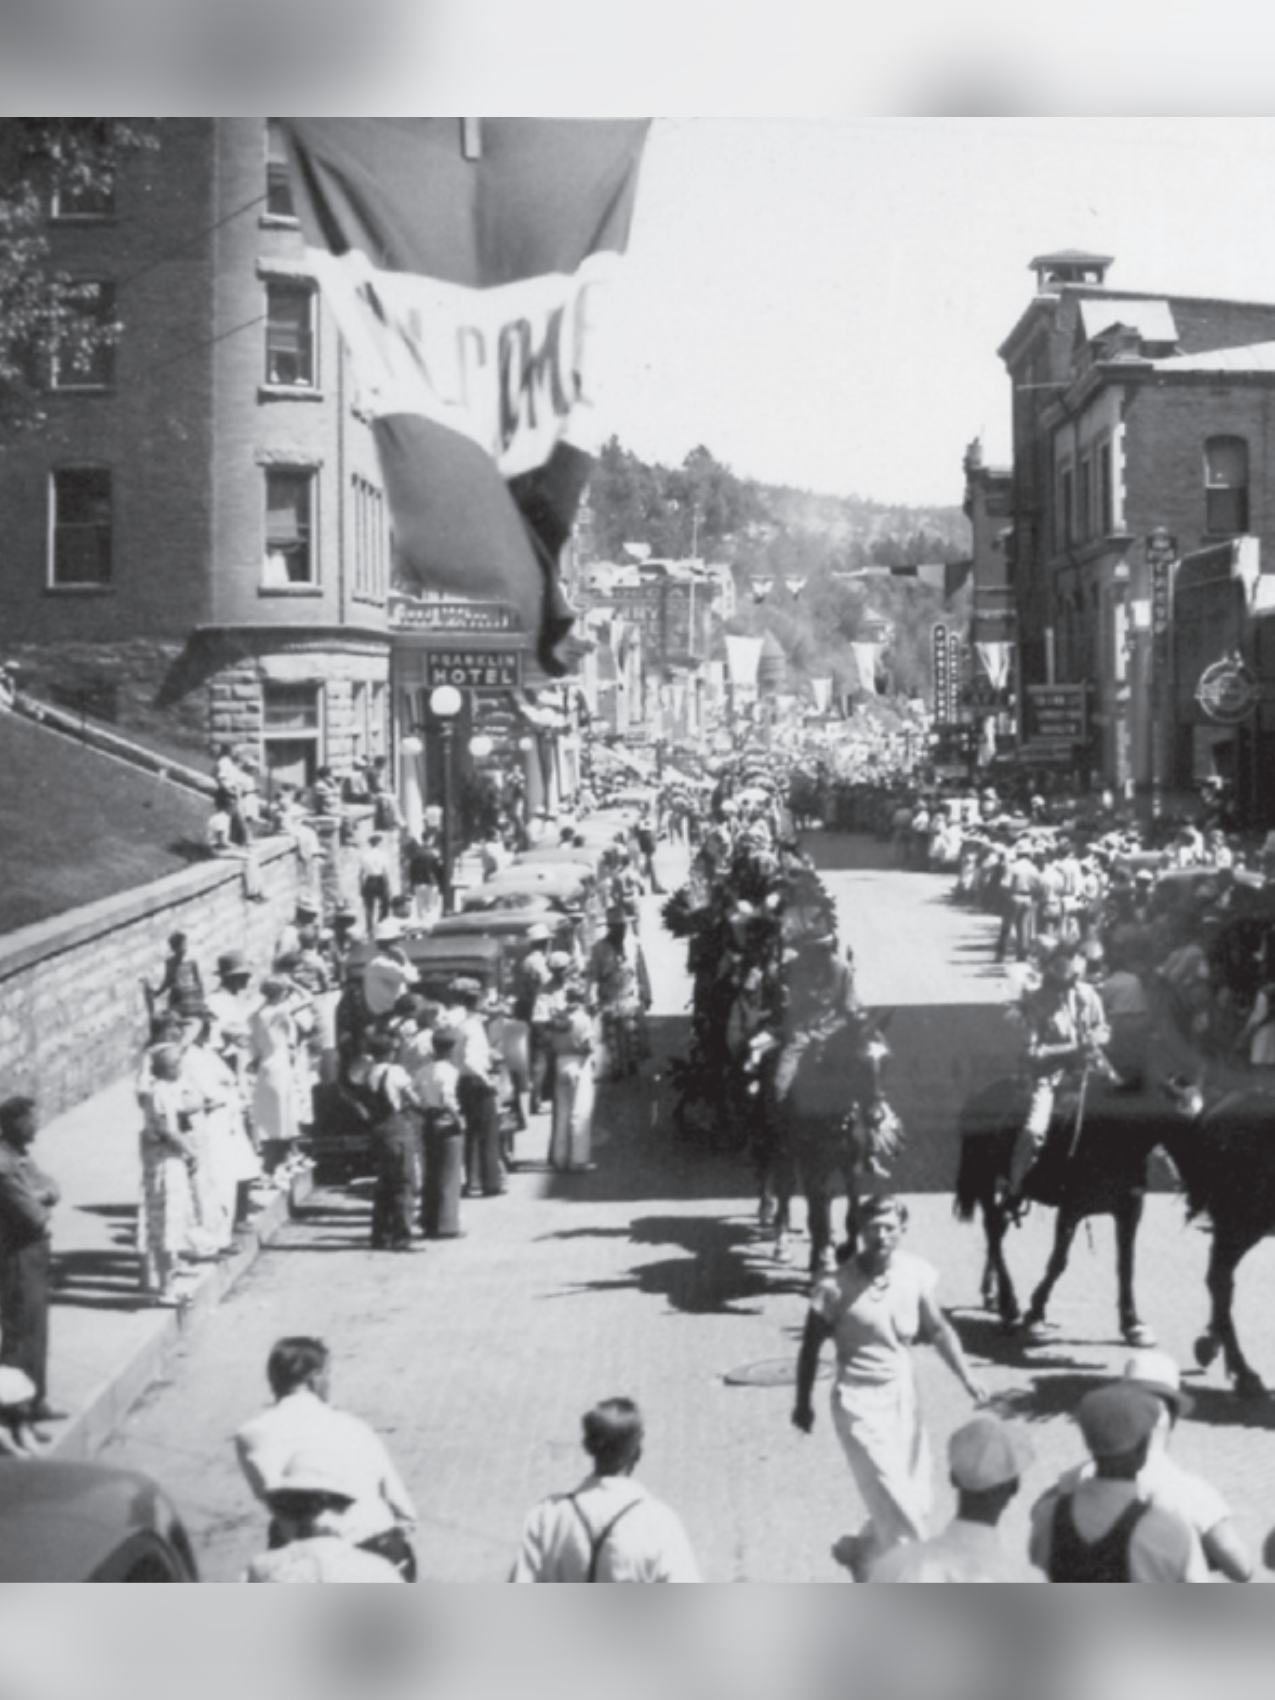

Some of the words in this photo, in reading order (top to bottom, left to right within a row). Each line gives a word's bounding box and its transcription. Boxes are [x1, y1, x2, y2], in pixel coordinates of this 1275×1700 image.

[353, 279, 605, 453] WLCOME
[429, 654, 516, 667] FRANKLIN
[433, 668, 513, 685] HOTEL
